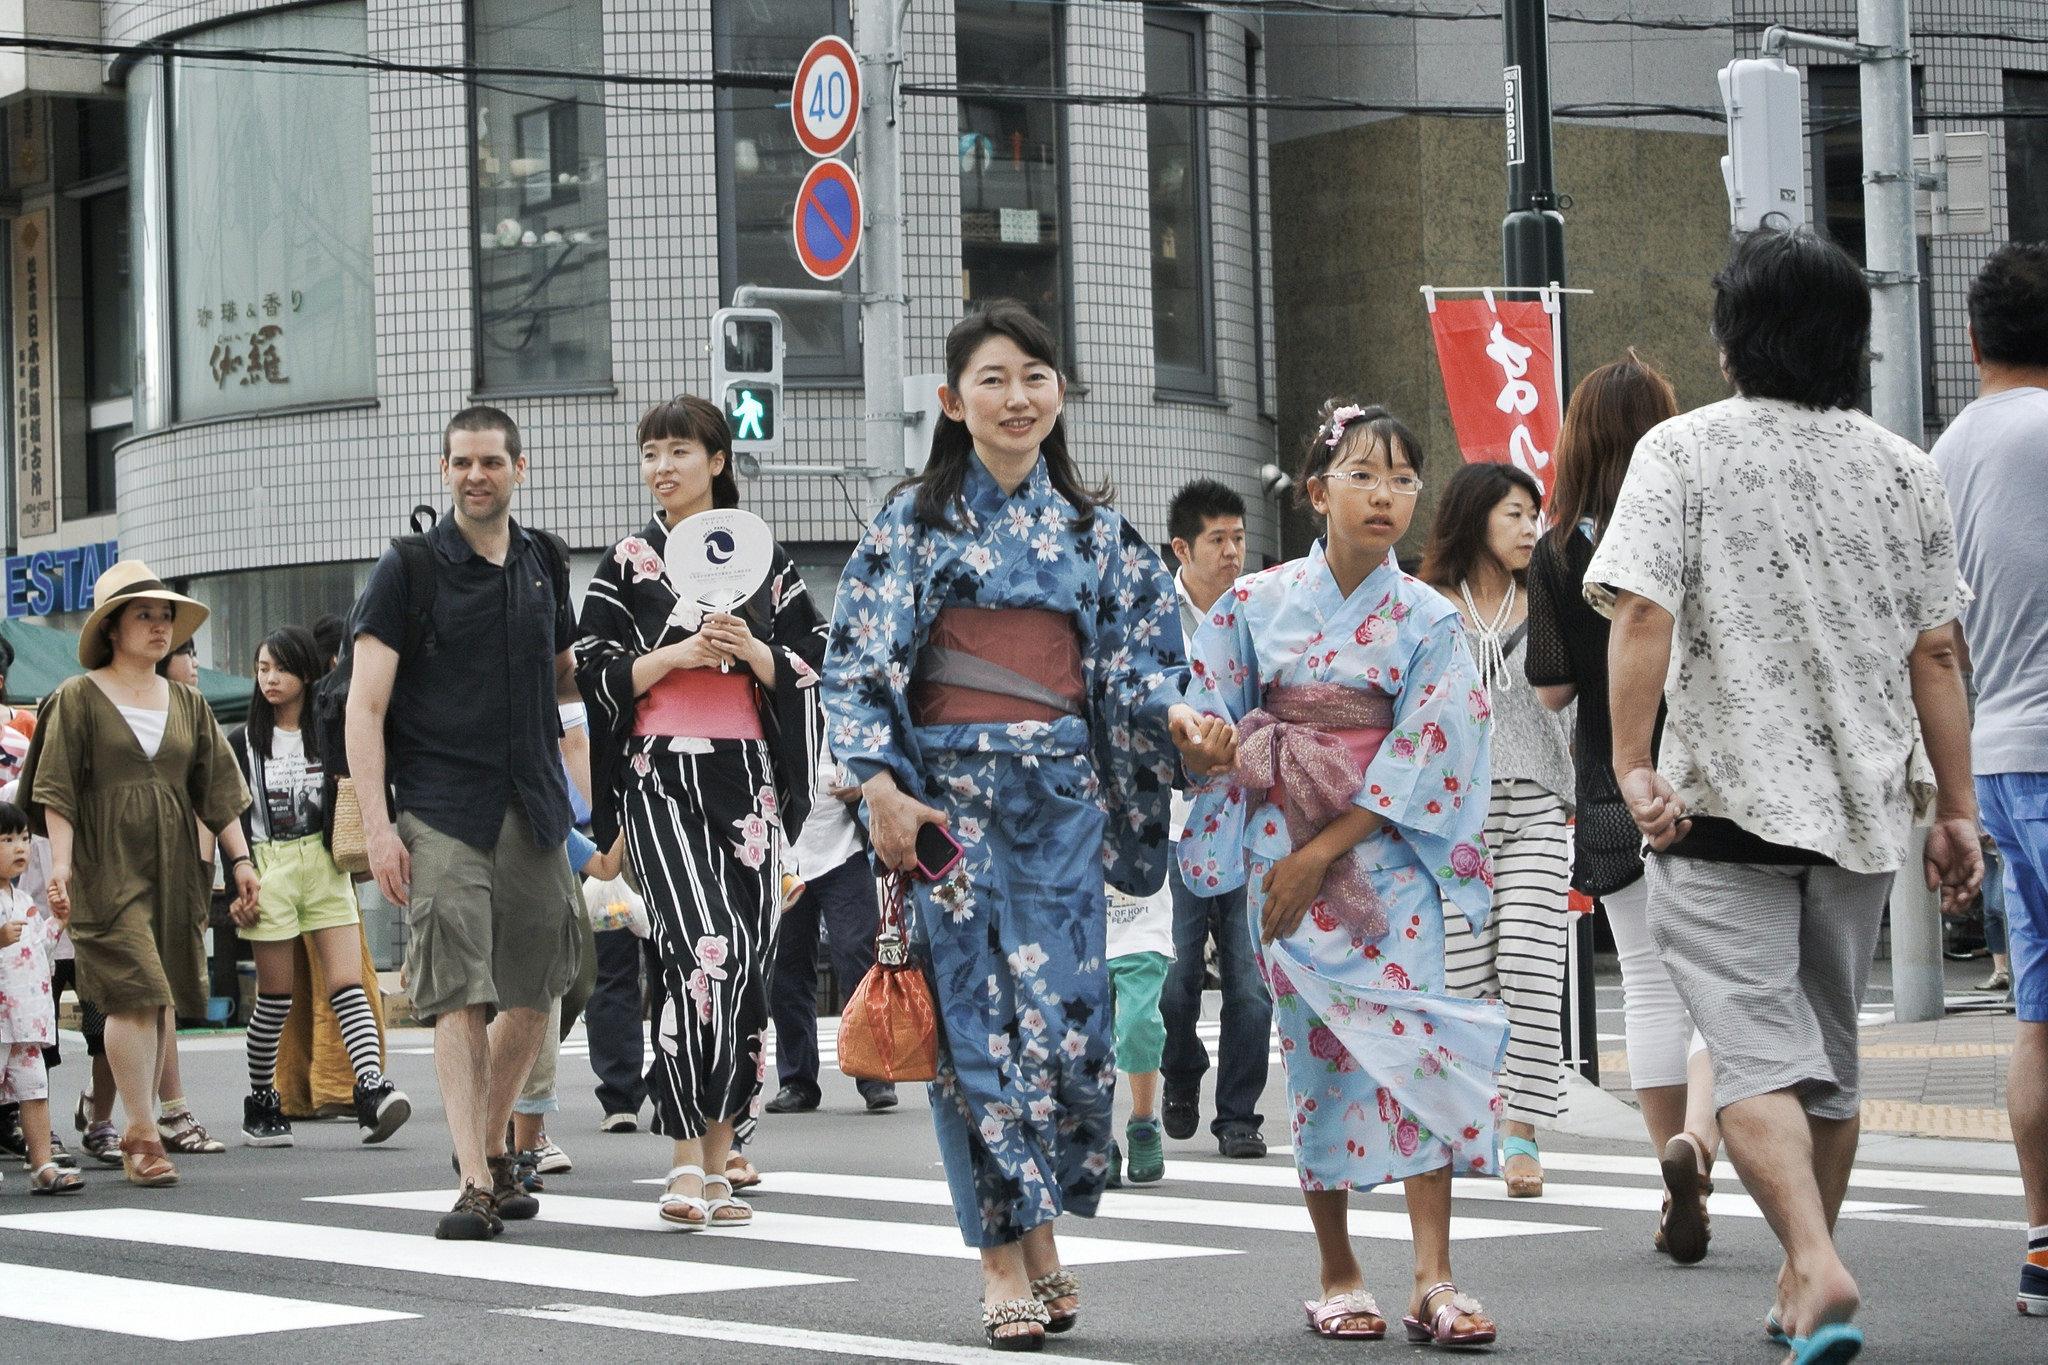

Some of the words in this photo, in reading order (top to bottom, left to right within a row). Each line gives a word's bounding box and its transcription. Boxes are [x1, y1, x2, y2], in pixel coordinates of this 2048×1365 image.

[809, 71, 845, 122] 40
[1505, 81, 1516, 160] 90621
[714, 526, 734, 534] PARTNER
[1114, 909, 1127, 917] OF
